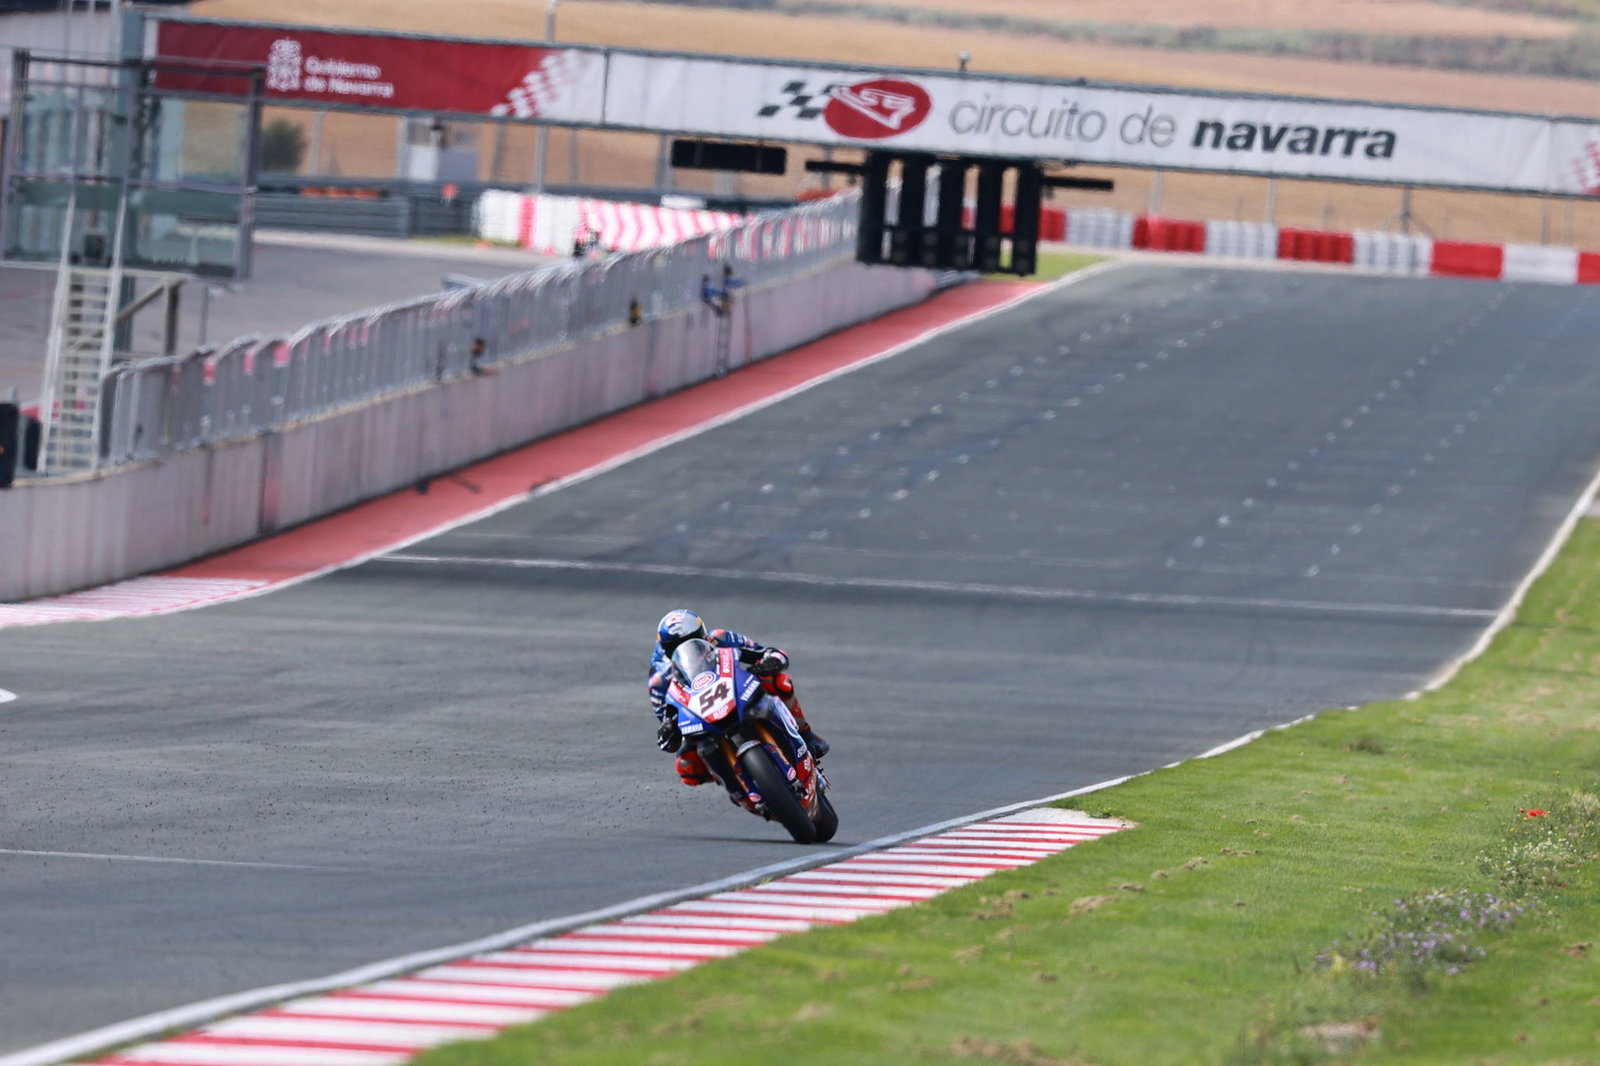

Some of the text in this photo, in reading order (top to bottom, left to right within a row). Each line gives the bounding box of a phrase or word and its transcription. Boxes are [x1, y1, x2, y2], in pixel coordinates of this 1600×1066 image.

[305, 56, 381, 79] Gobierno
[304, 77, 394, 98] de Navarra
[949, 93, 1397, 159] circuito de navarra
[699, 681, 730, 716] 54
[740, 680, 760, 702] YAMAHA
[681, 722, 704, 736] YAMAHA
